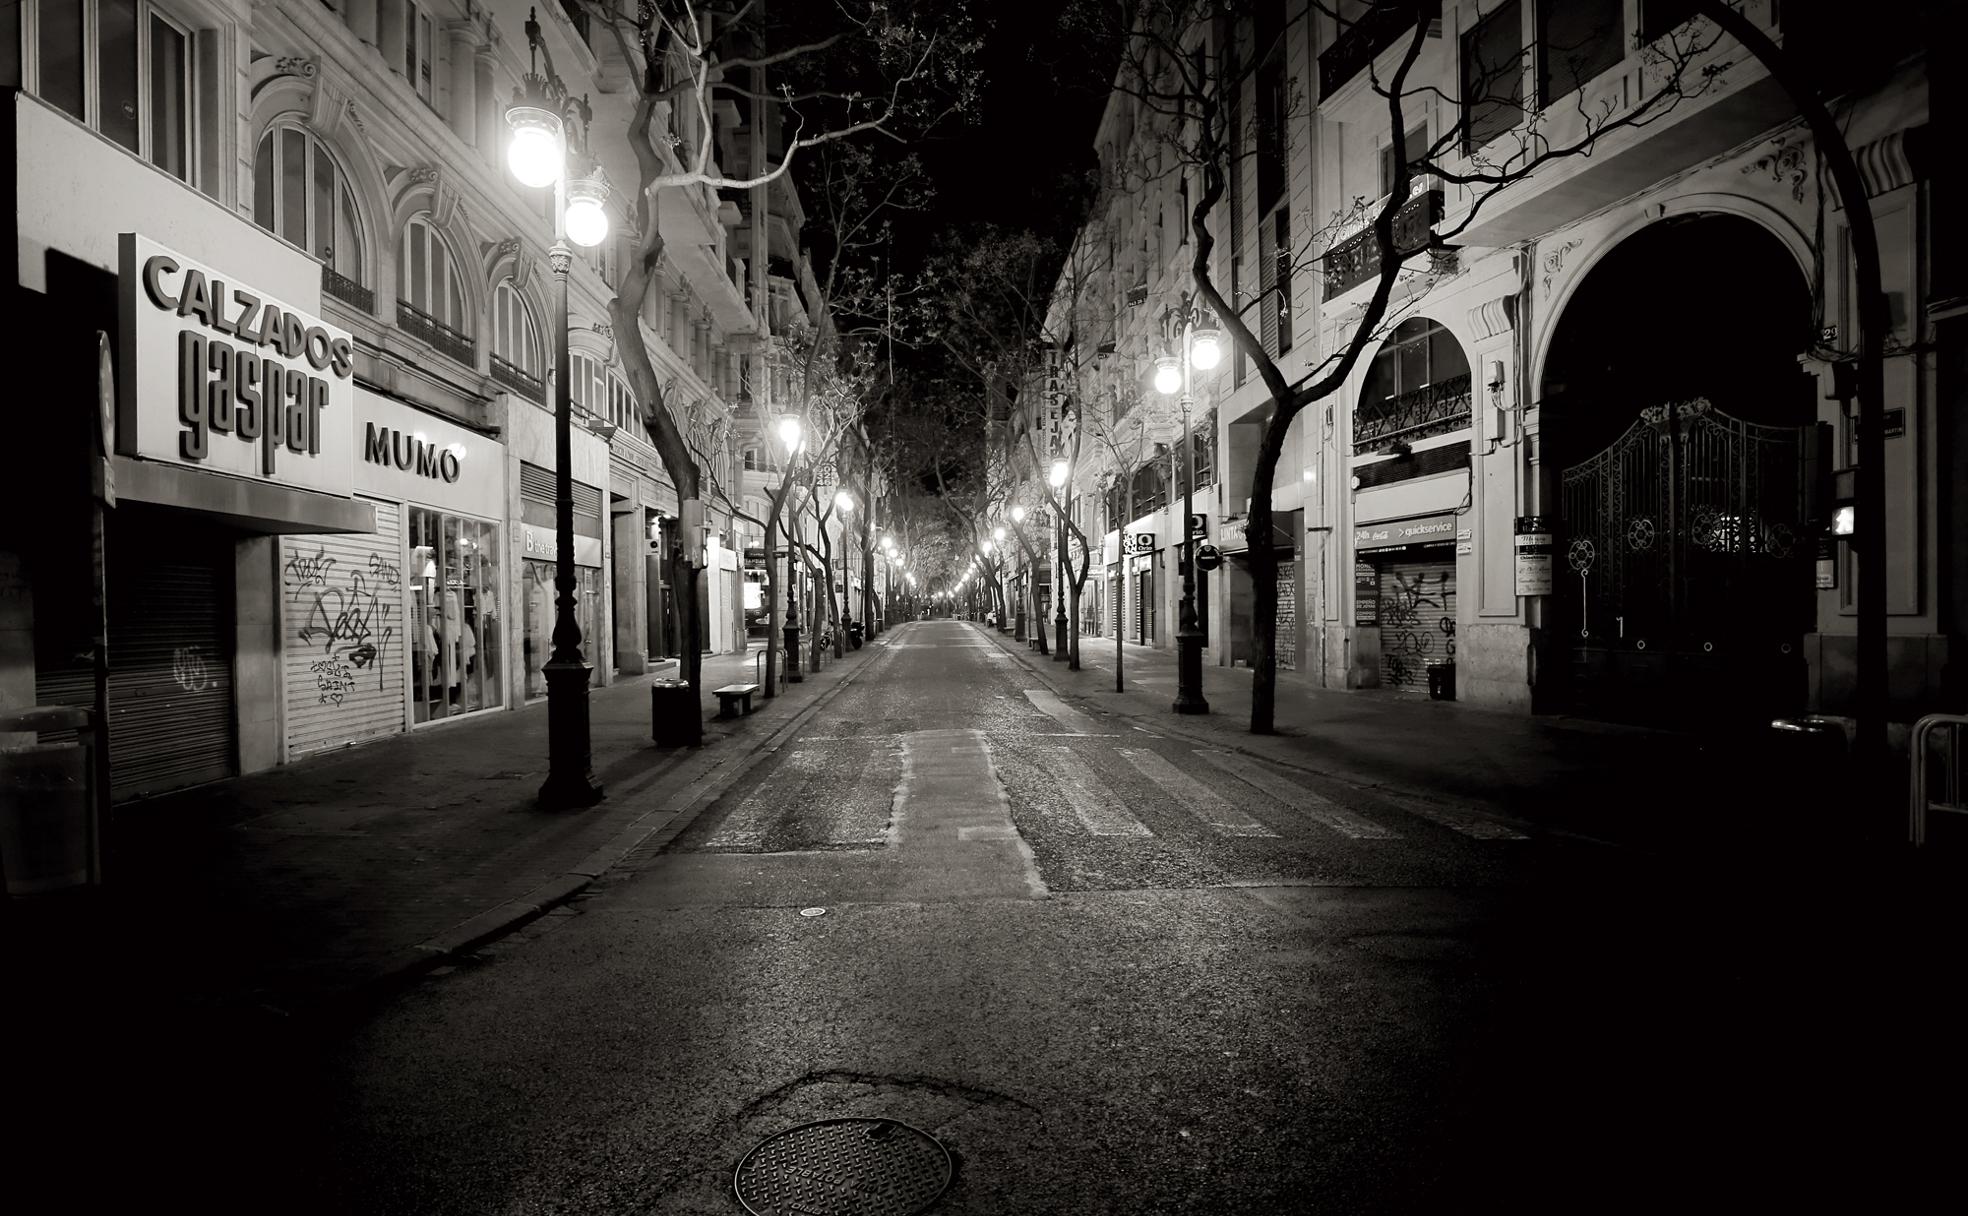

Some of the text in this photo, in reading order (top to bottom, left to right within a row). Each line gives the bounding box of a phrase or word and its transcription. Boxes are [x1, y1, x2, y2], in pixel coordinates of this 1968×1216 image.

[143, 255, 353, 380] CALZADOS
[1824, 327, 1838, 340] 29
[178, 330, 330, 477] gaspar
[365, 422, 461, 483] MUMO
[1405, 523, 1453, 537] quickservice
[785, 1166, 846, 1186] POTABLE
